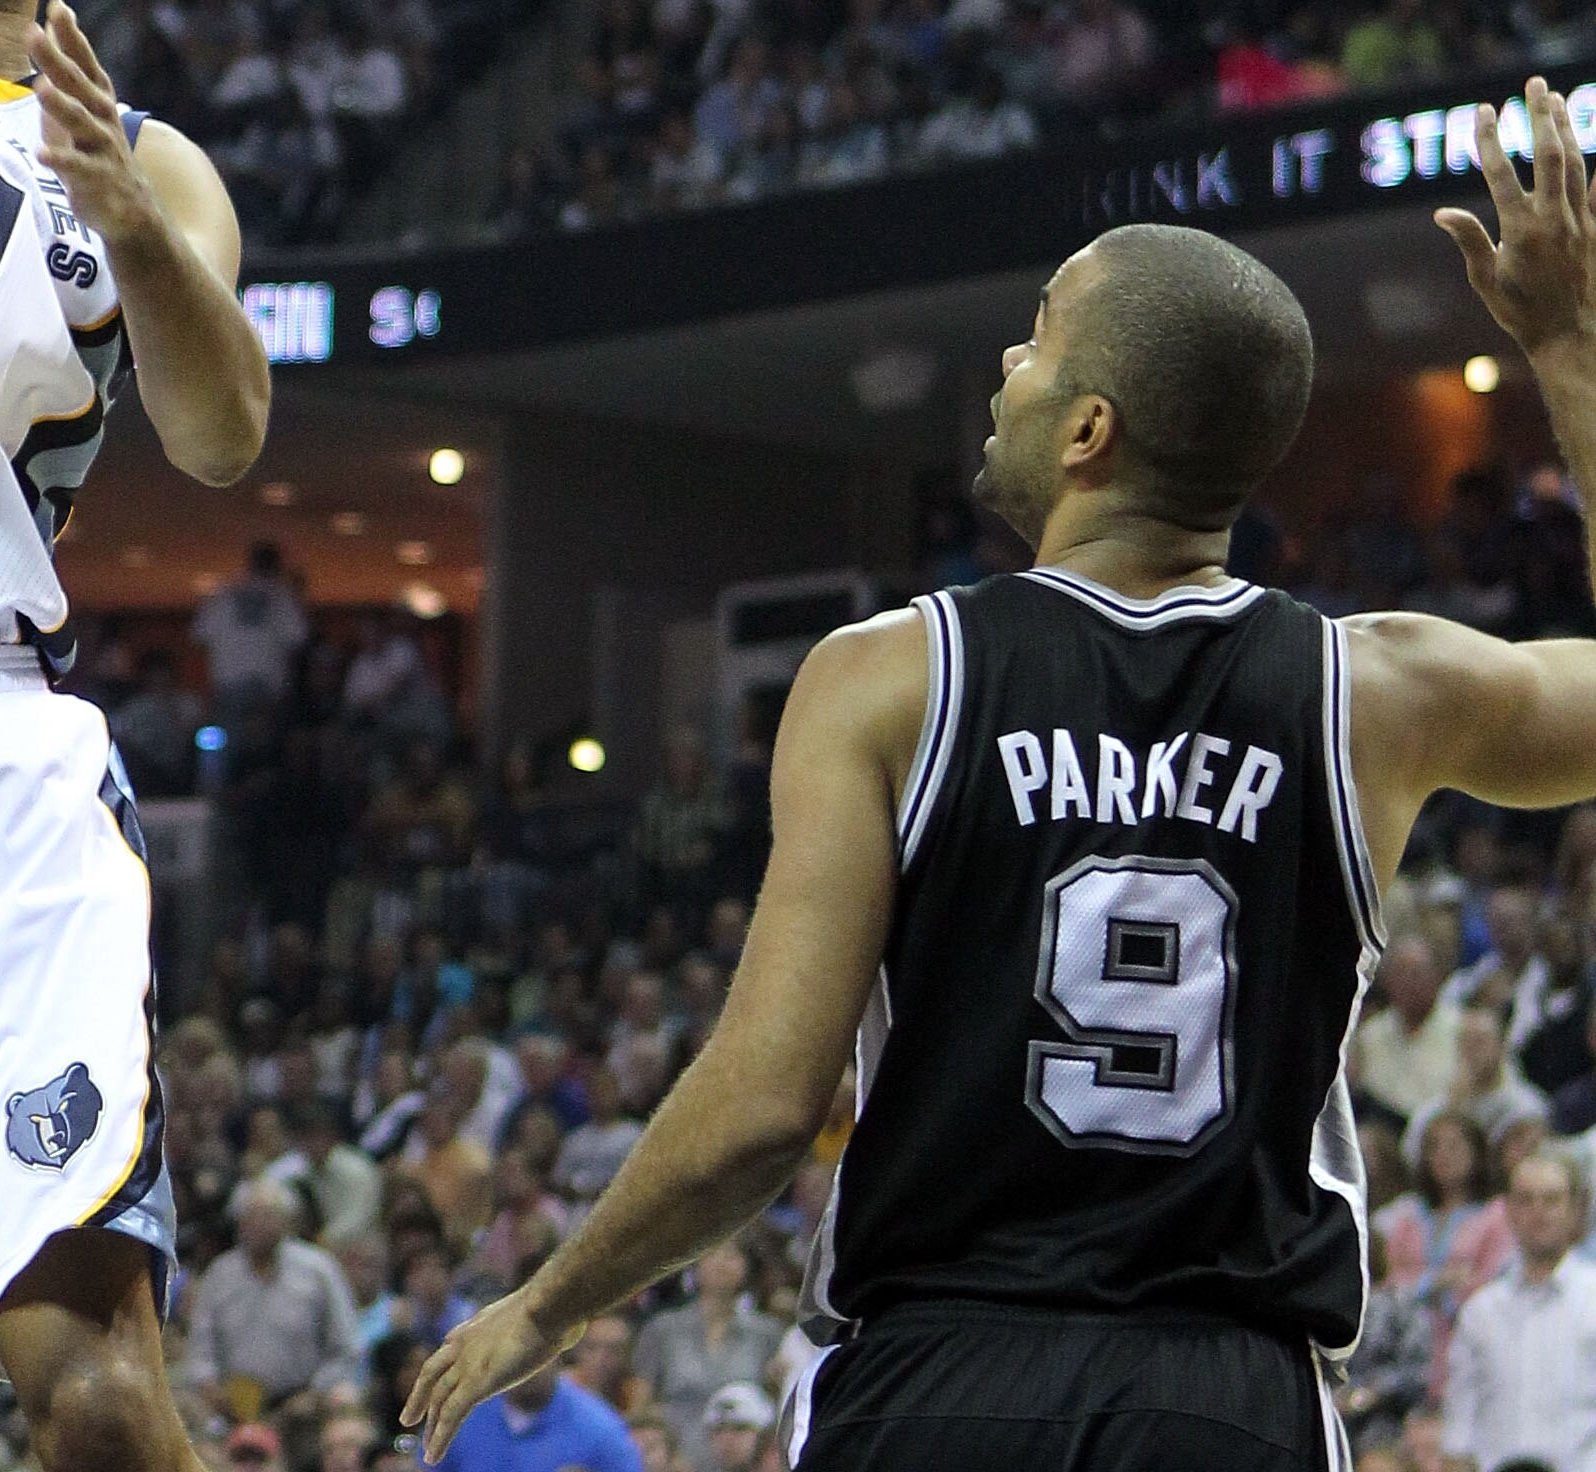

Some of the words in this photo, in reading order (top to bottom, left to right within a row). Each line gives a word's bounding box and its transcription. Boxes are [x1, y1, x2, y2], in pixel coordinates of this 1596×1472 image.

[1270, 128, 1336, 202] IT
[997, 728, 1284, 844] PARKER
[1023, 854, 1240, 1159] 9
